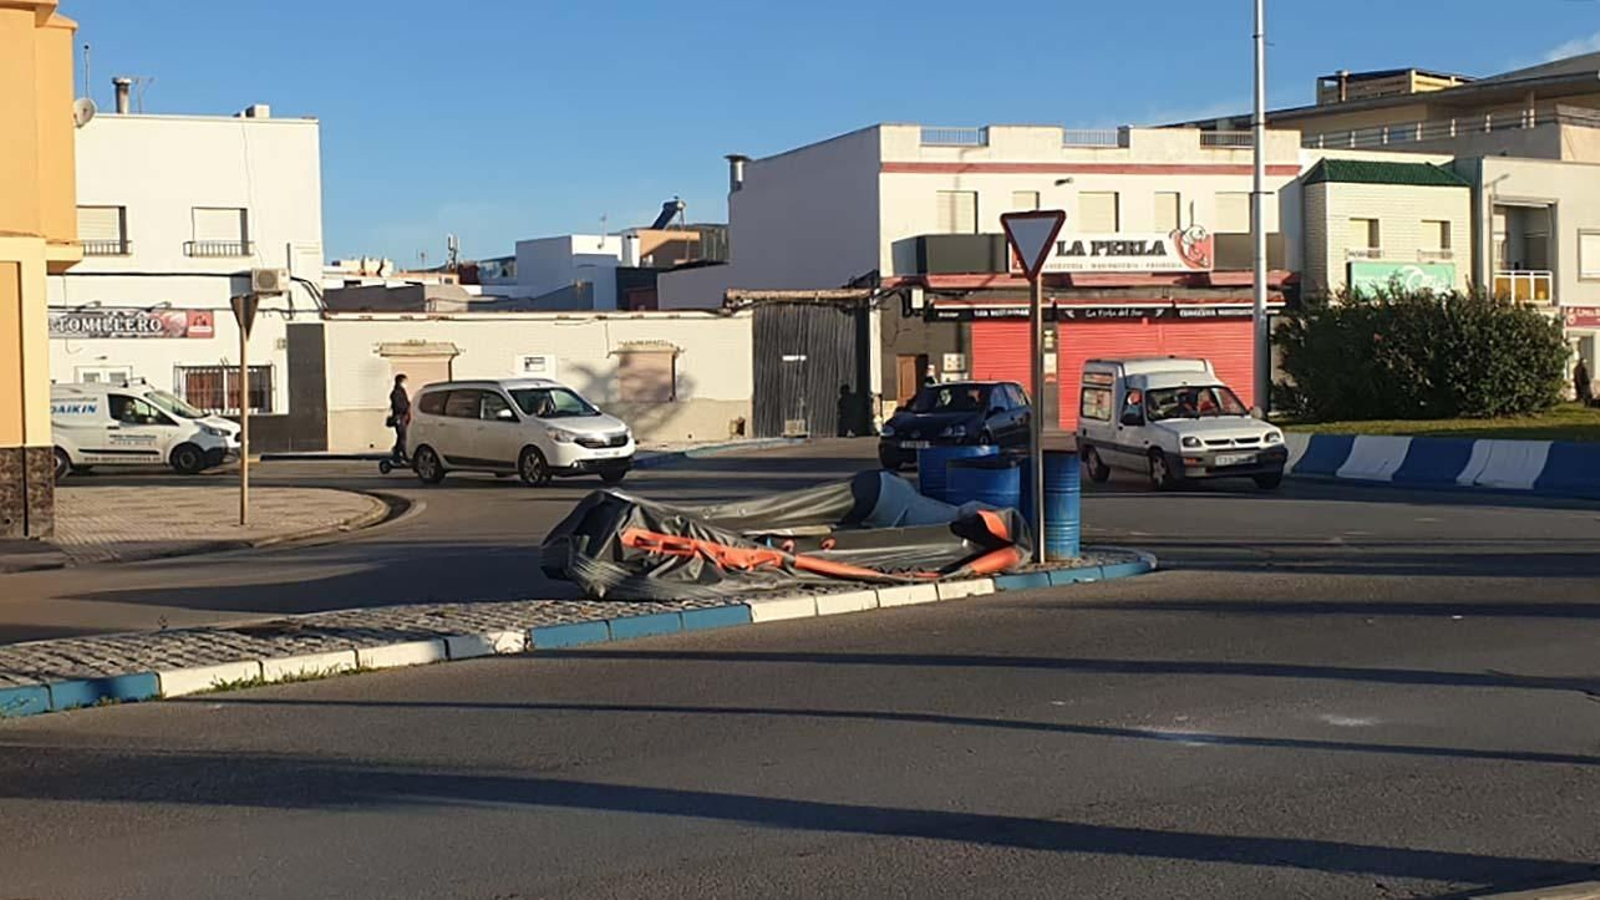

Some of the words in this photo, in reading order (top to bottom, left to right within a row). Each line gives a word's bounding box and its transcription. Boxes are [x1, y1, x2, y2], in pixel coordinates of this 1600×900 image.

[1056, 240, 1086, 257] LA
[1090, 240, 1167, 257] PERLA
[58, 317, 162, 332] TOMILLERO
